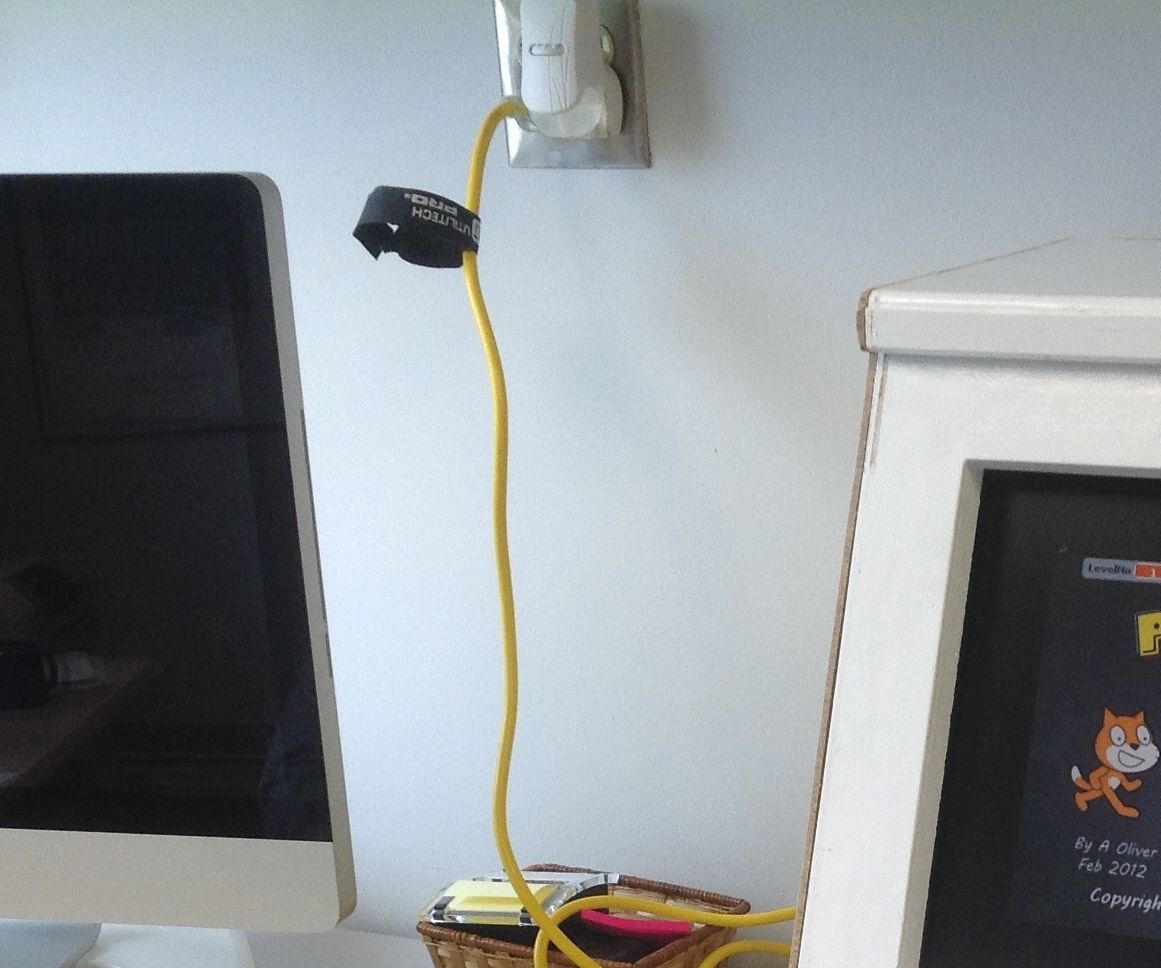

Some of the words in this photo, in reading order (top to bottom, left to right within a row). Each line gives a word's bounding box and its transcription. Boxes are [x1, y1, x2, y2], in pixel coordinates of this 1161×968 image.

[411, 193, 458, 216] PRO
[412, 206, 472, 237] UTILITECH
[1074, 836, 1093, 853] By
[1098, 839, 1111, 852] A
[1116, 842, 1159, 858] Oliver
[1078, 858, 1103, 873] Feb
[1108, 861, 1148, 879] 2012
